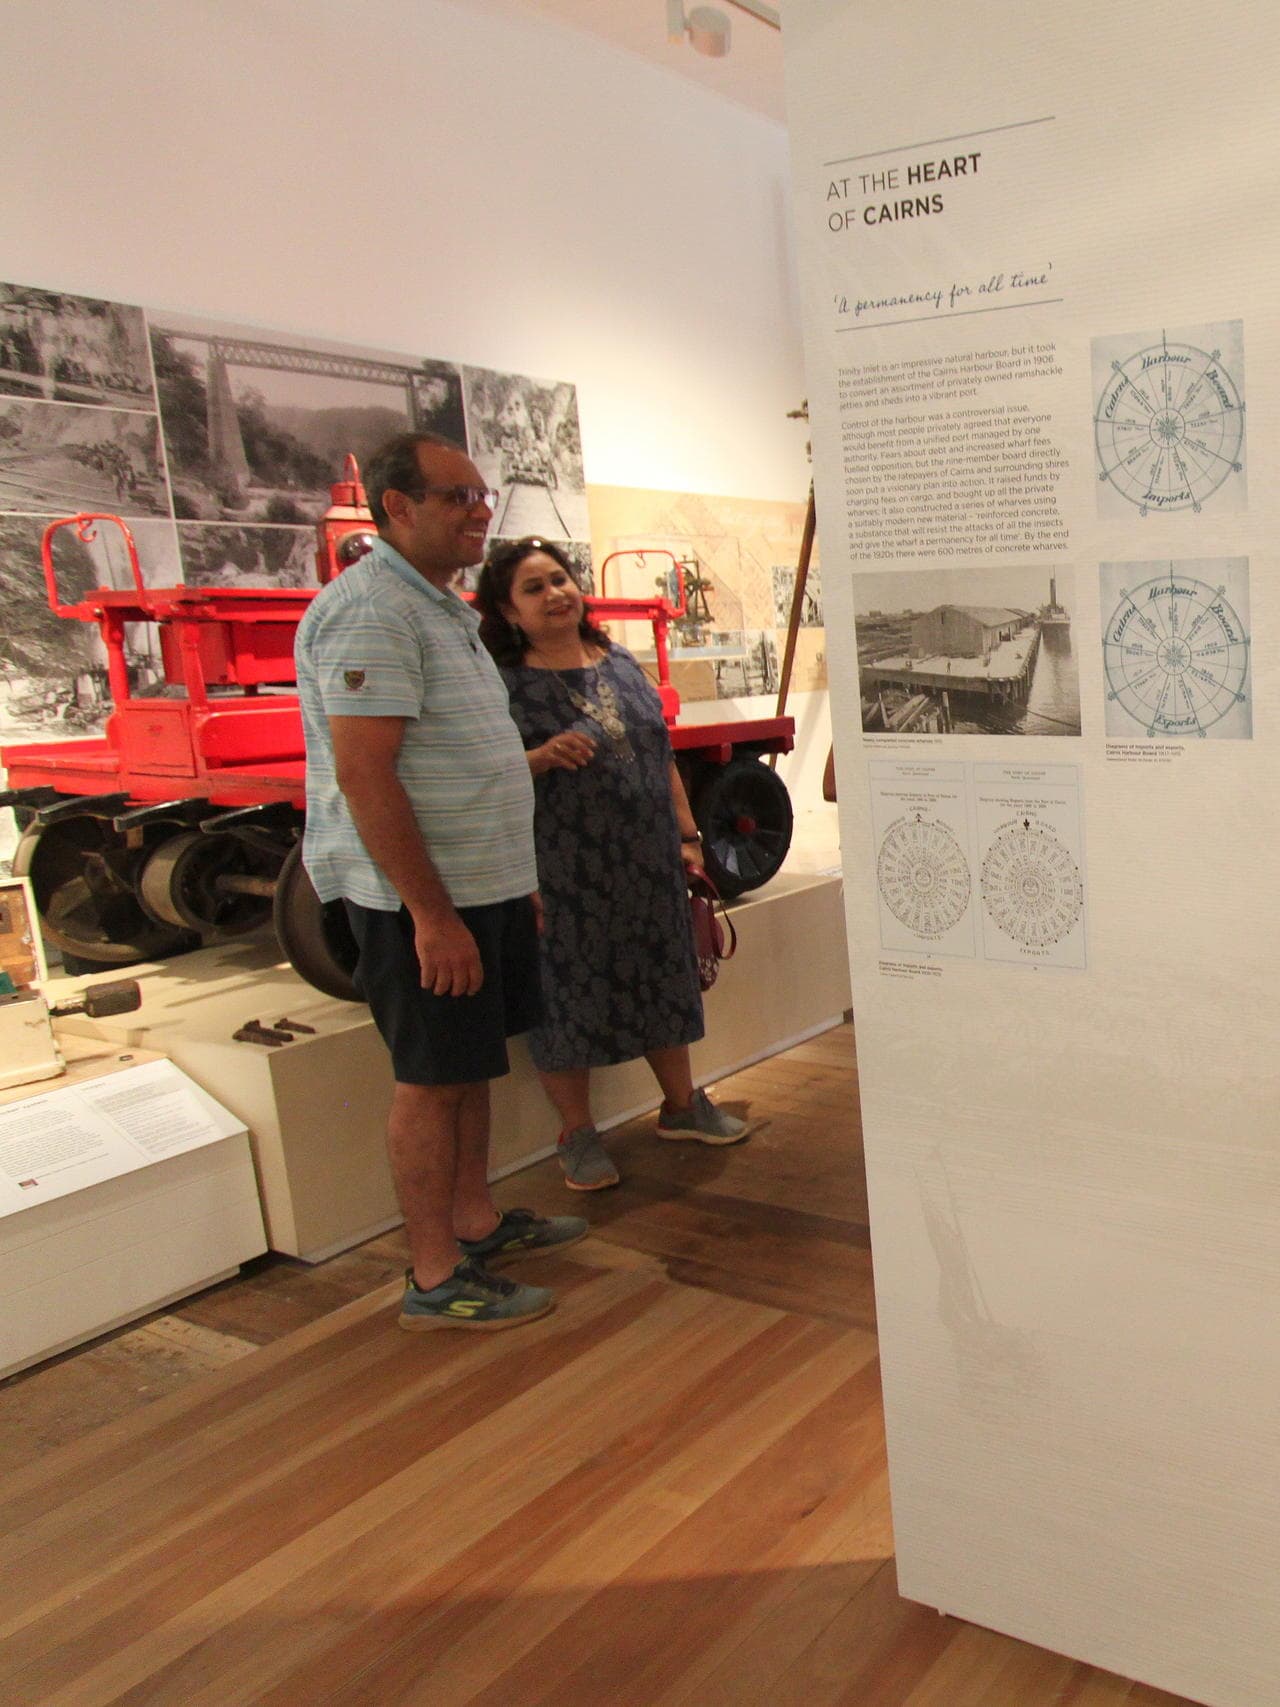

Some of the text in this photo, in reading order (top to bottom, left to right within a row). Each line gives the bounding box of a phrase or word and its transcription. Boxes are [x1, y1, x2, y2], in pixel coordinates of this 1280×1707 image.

[827, 153, 982, 201] AT THE HEART
[828, 193, 944, 232] OF CAIRNS
[854, 290, 943, 316] permanency
[950, 284, 973, 308] for
[978, 274, 1004, 294] all
[901, 356, 942, 369] impressive
[944, 352, 972, 362] natural
[1011, 346, 1025, 355] but
[1036, 343, 1055, 352] took
[1141, 351, 1191, 370] Harbour
[838, 378, 850, 386] the
[918, 369, 930, 377] the
[933, 366, 957, 376] Cairns
[960, 362, 992, 373] Harbour
[995, 359, 1020, 369] Board
[1034, 355, 1053, 365] 1906
[849, 387, 876, 396] convert
[947, 375, 981, 387] privately
[984, 372, 1012, 382] owned
[1014, 366, 1062, 378] ramshackle
[864, 398, 878, 406] and
[905, 394, 920, 402] into
[929, 390, 956, 399] vibrant
[1104, 376, 1129, 418] Cairns
[1206, 369, 1233, 409] Board
[841, 419, 868, 428] Control
[880, 416, 892, 424] the
[895, 413, 924, 423] harbour
[952, 406, 1004, 418] controversial
[842, 415, 1051, 440] although most people privately agreed that everyone
[867, 439, 893, 448] benefit
[896, 437, 914, 445] from
[952, 433, 968, 442] port
[971, 429, 1009, 440] managed
[880, 450, 900, 458] Fears
[903, 447, 925, 456] about
[928, 446, 946, 454] debt
[949, 444, 963, 452] and
[1007, 439, 1030, 448] wharf
[1033, 437, 1050, 445] fees
[915, 458, 928, 466] but
[930, 457, 943, 465] the
[1002, 451, 1026, 460] board
[1029, 448, 1060, 459] directly
[884, 459, 1069, 480] the Cairns and surrounding shires
[865, 485, 877, 494] put
[923, 480, 939, 490] plan
[996, 474, 1021, 483] raised
[1024, 472, 1046, 481] funds
[936, 491, 951, 499] and
[953, 489, 981, 499] bought
[1008, 486, 1022, 494] the
[1024, 484, 1054, 494] private
[906, 495, 1056, 512] constructed series wharves using
[885, 515, 914, 524] modern
[934, 512, 966, 521] material
[894, 527, 909, 535] that
[926, 525, 946, 533] resist
[949, 524, 962, 532] the
[965, 522, 993, 531] attacks
[1006, 521, 1015, 529] all
[1018, 520, 1031, 528] the
[1034, 518, 1063, 527] insects
[849, 540, 862, 548] and
[926, 536, 972, 546] permanency
[989, 533, 998, 541] all
[1052, 530, 1069, 538] end
[995, 544, 1030, 552] concrete
[1148, 585, 1197, 600] Harbour
[1113, 604, 1138, 643] Cairns
[1211, 603, 1238, 644] Board
[1155, 714, 1197, 729] Exports
